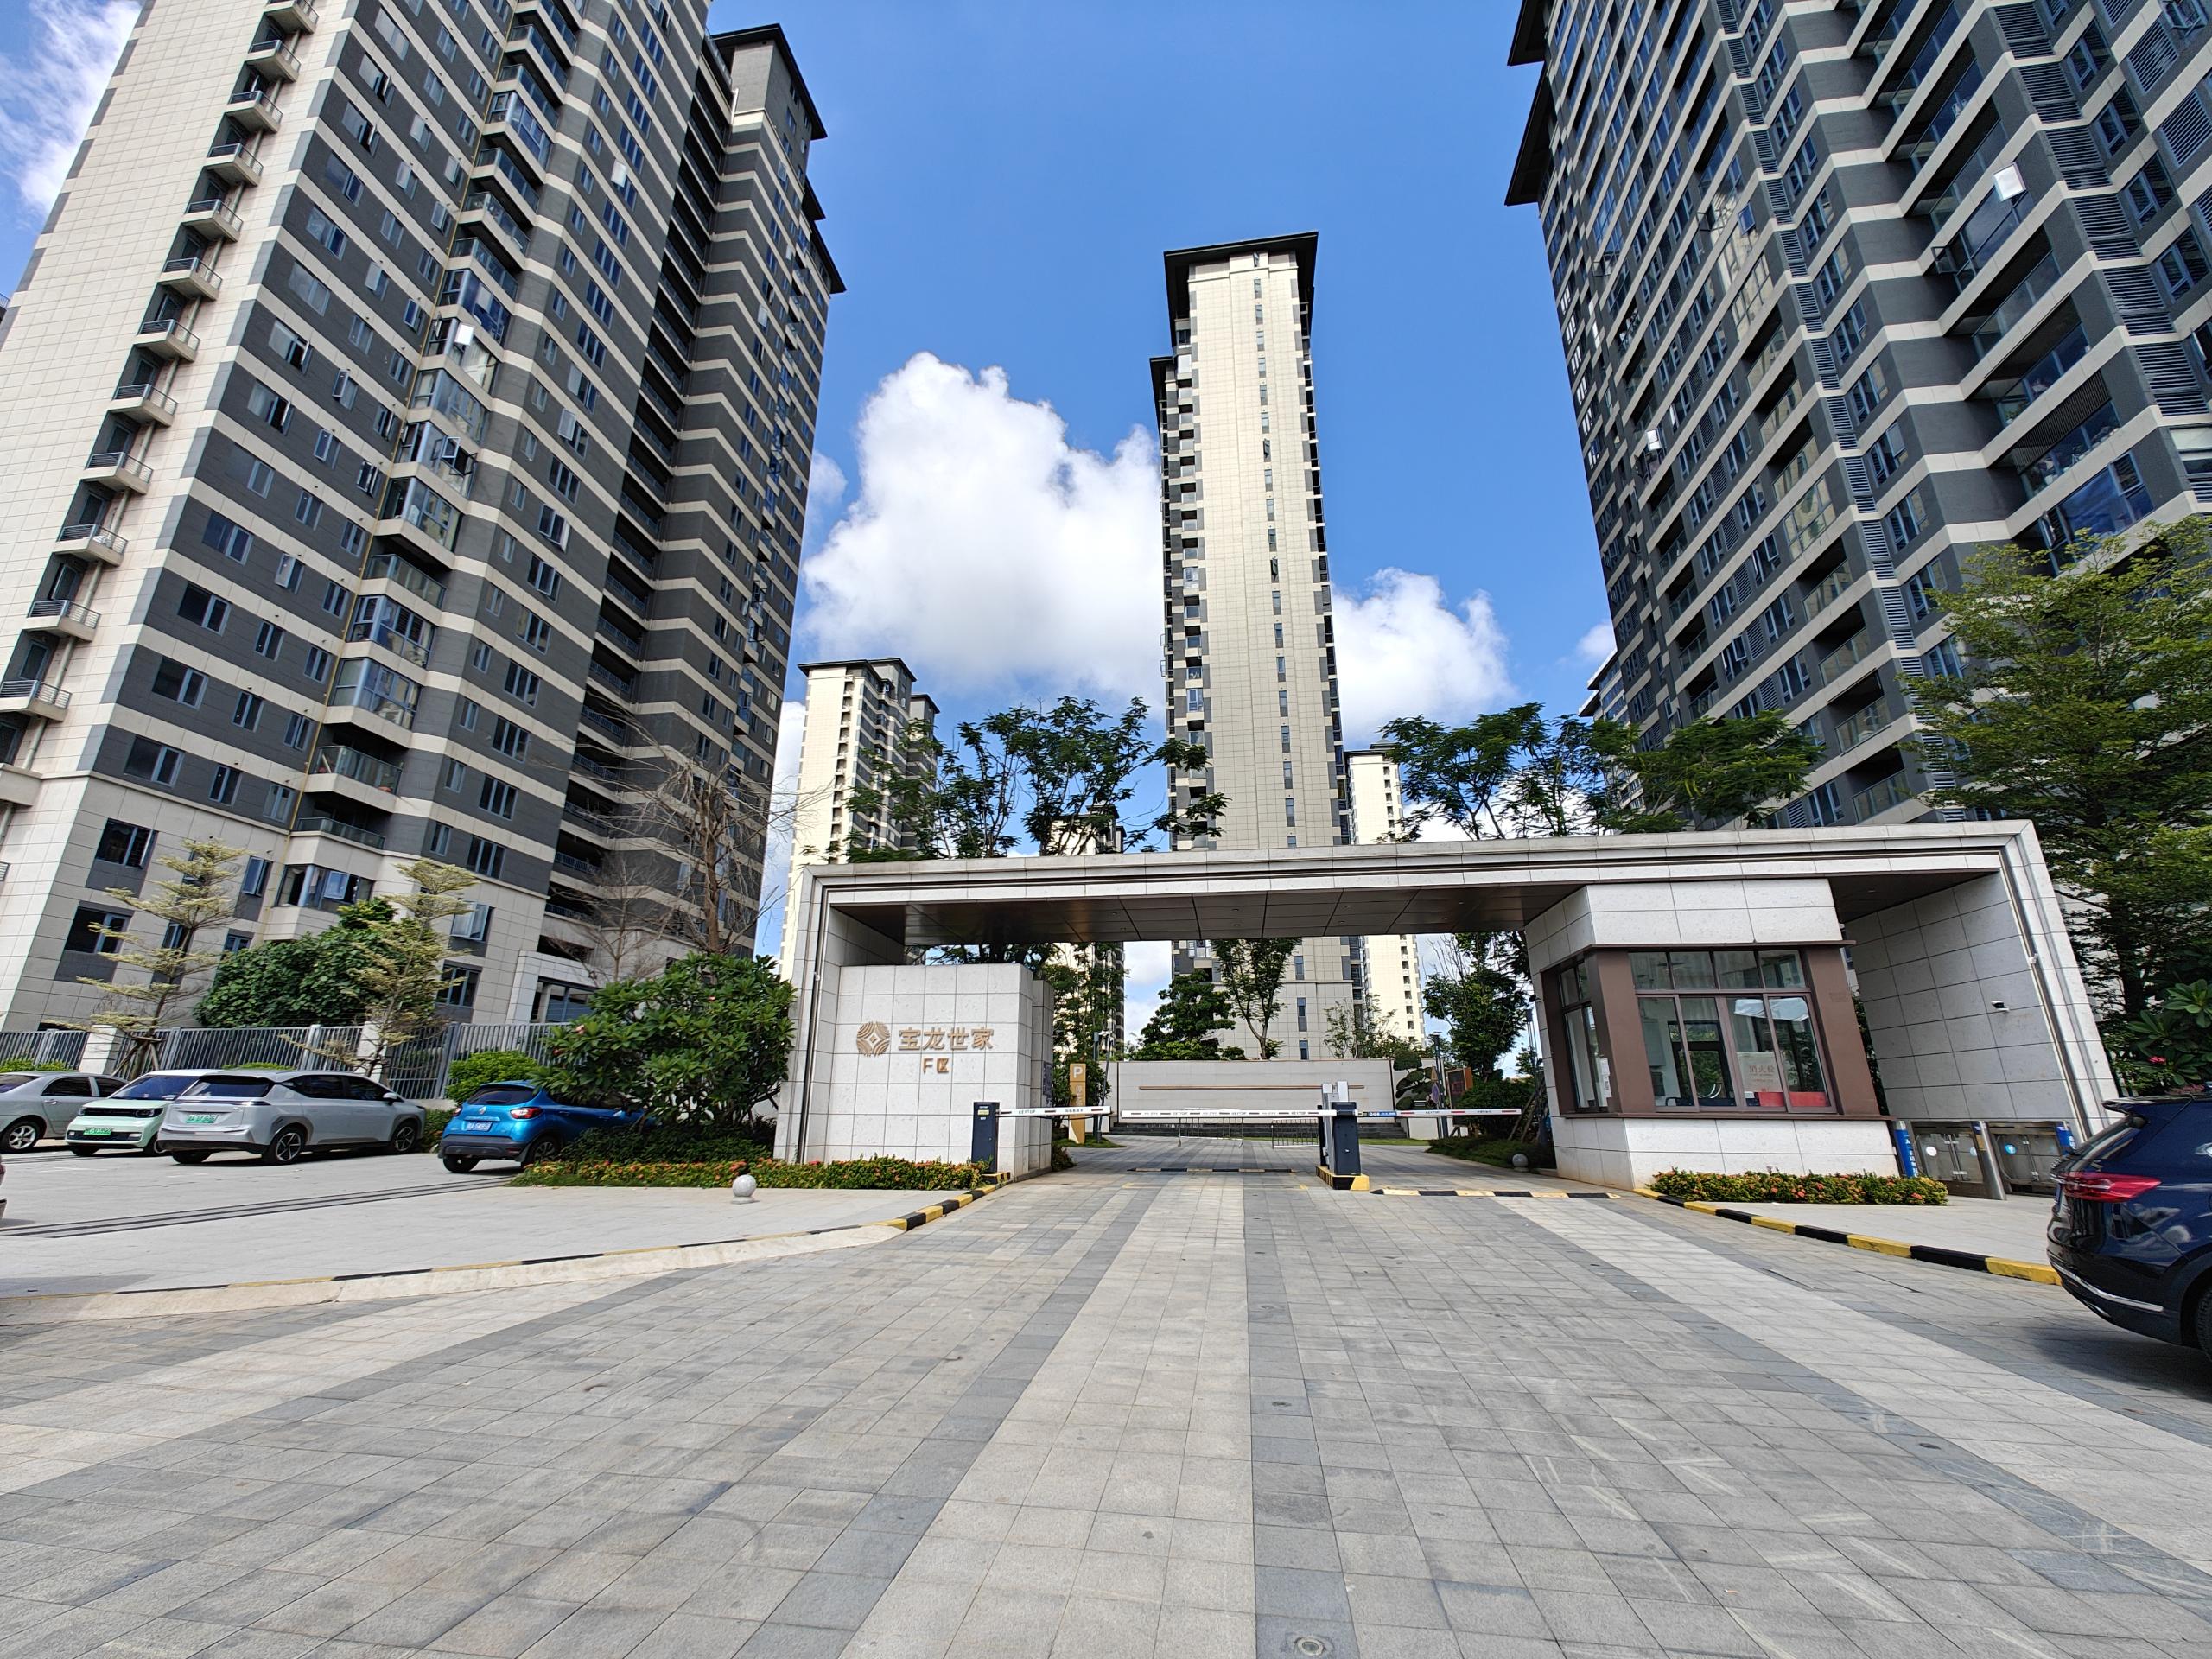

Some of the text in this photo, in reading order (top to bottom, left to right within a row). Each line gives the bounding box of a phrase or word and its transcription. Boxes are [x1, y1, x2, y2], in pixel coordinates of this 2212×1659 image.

[898, 1027, 995, 1051] 宝龙世家
[923, 1057, 950, 1073] F区
[1073, 1066, 1084, 1079] P
